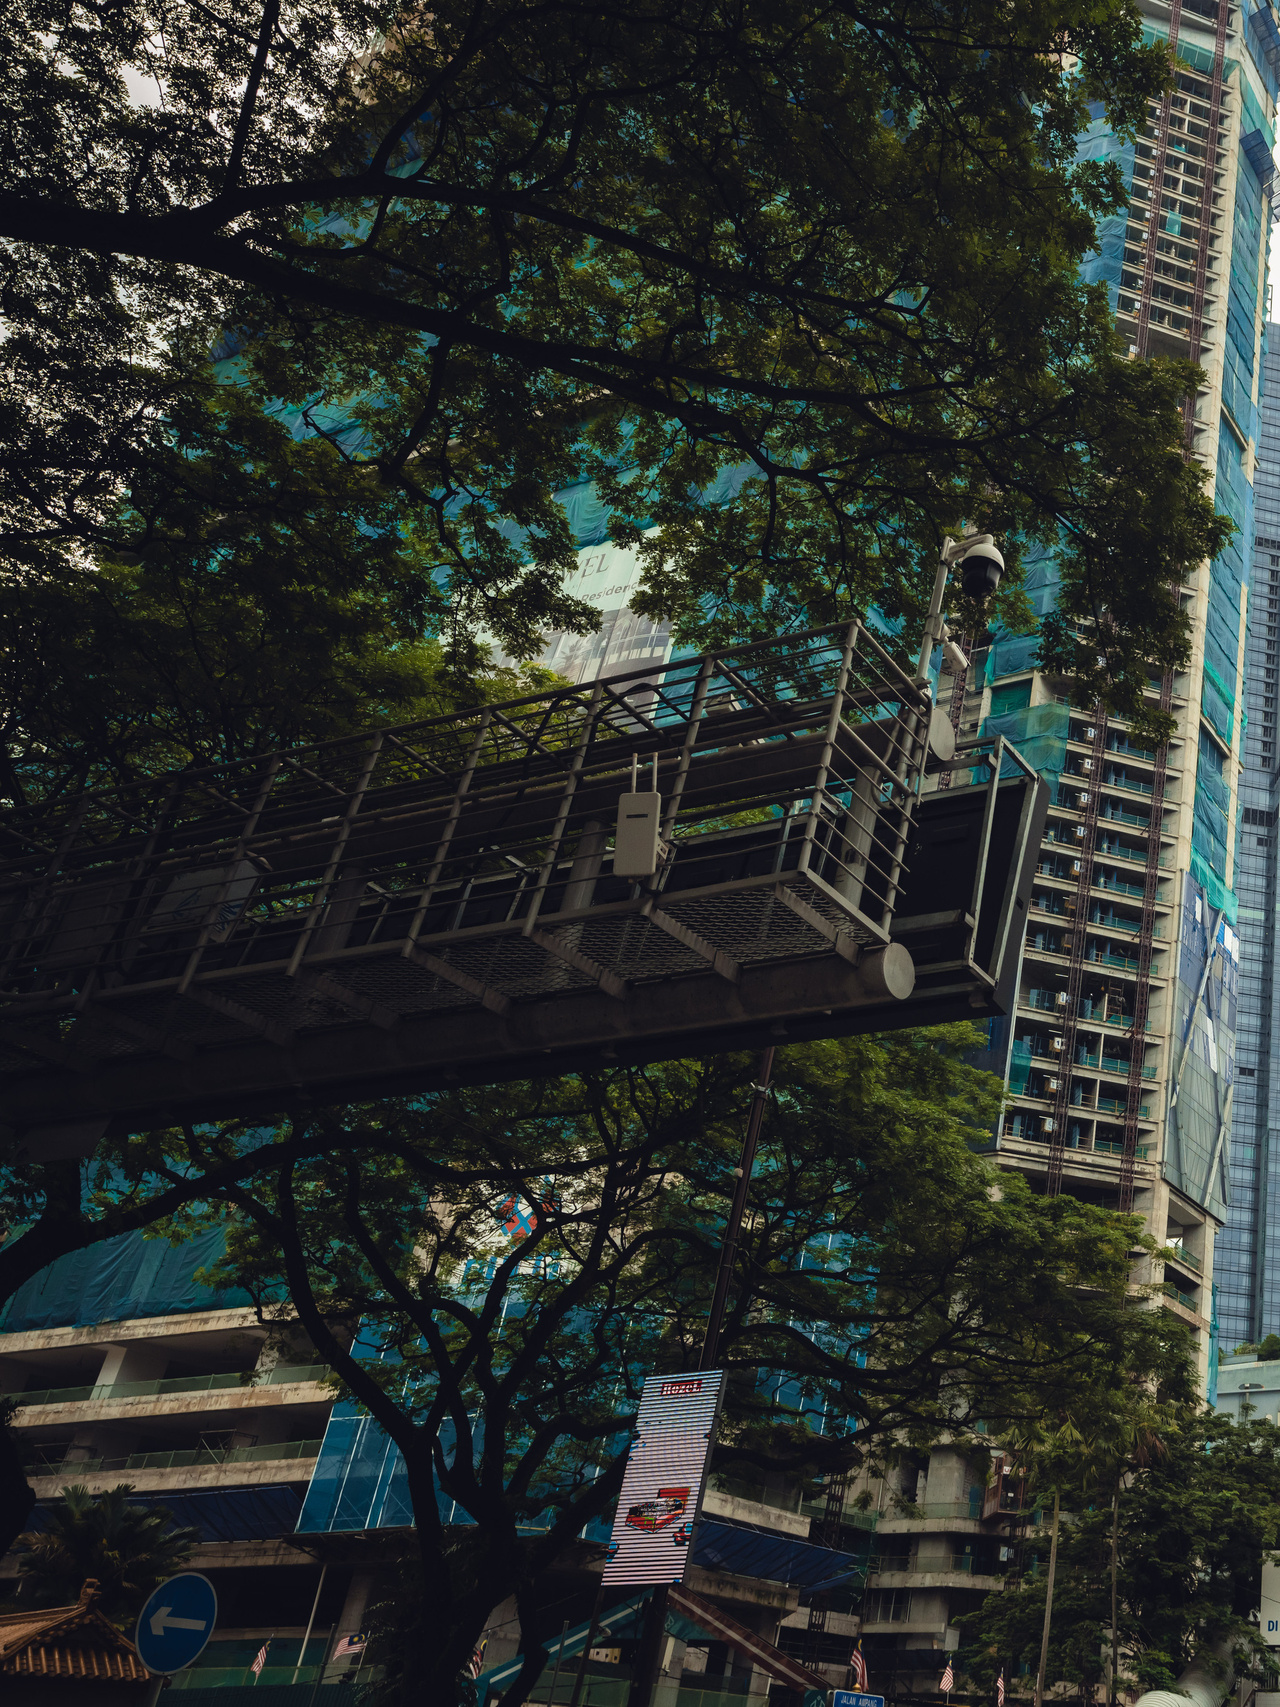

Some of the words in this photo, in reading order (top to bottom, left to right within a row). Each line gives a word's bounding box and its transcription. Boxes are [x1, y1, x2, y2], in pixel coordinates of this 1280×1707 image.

[1267, 1620, 1278, 1632] DI
[841, 1695, 856, 1705] JALAN
[858, 1698, 877, 1707] AMPANG
